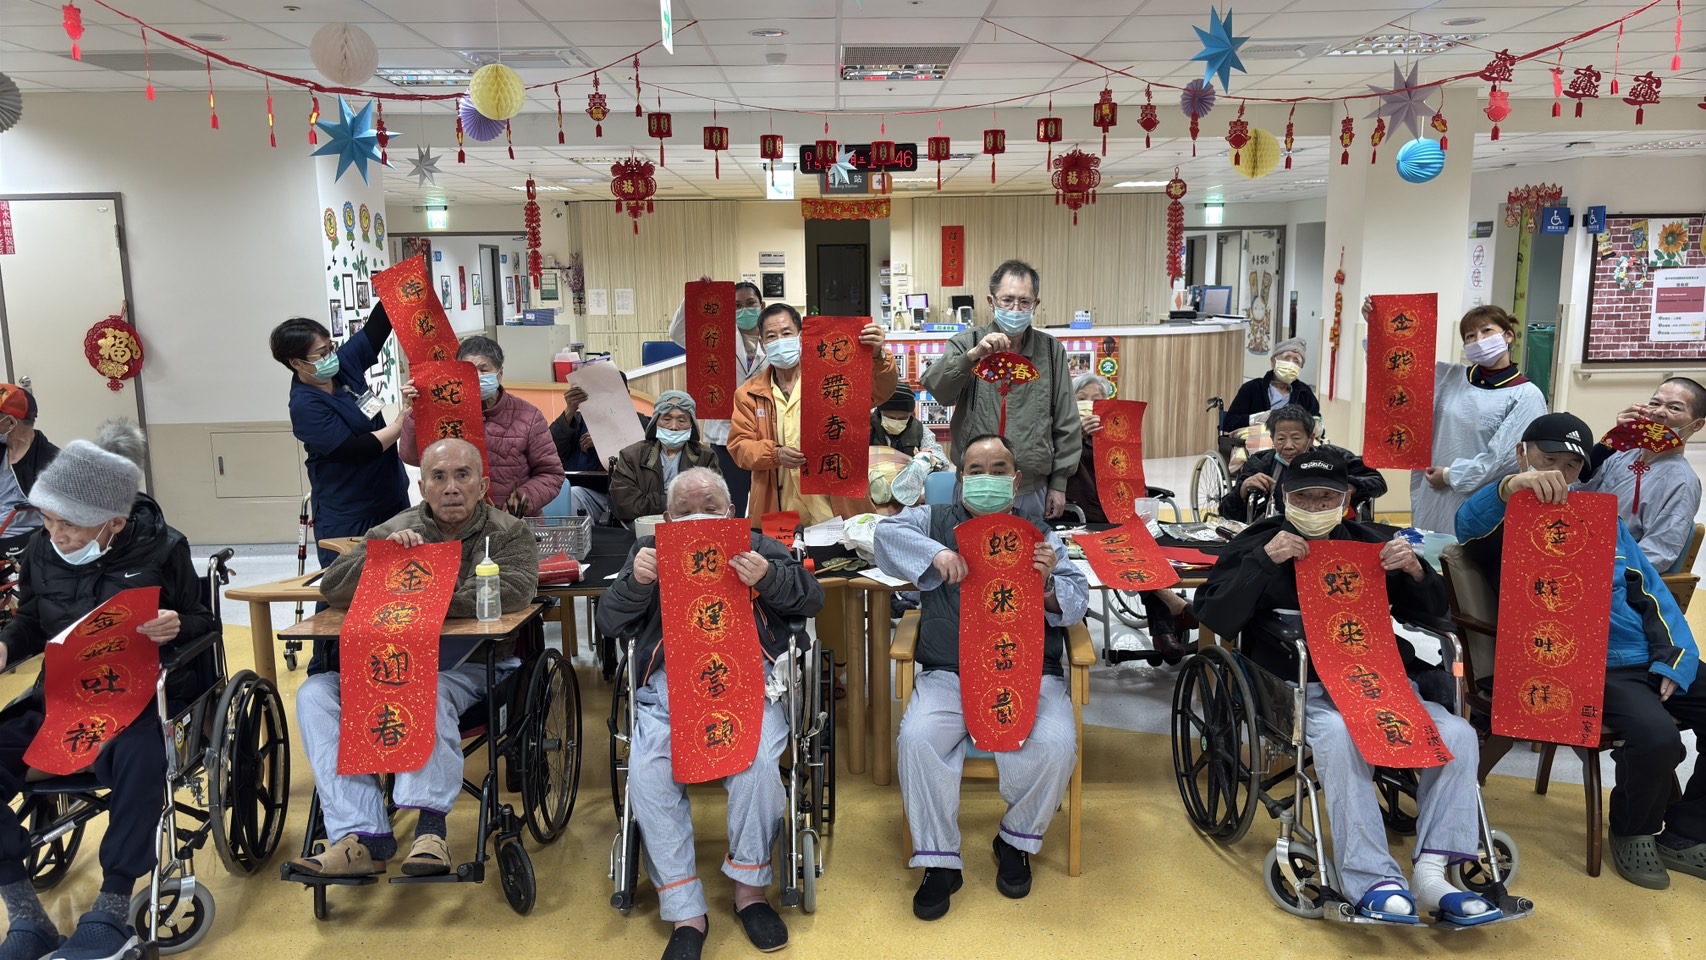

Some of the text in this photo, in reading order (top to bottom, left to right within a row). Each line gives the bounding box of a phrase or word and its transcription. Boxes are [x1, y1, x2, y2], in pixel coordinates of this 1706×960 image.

[98, 327, 131, 364] 福
[703, 302, 719, 404] 蛇行天下
[816, 337, 850, 481] 蛇舞春風
[1011, 363, 1032, 380] 春
[64, 611, 126, 753] 金蛇吐祥
[370, 559, 432, 747] 金蛇迎春
[691, 547, 734, 748] 蛇運當頭
[989, 531, 1018, 725] 蛇來富貴
[1323, 565, 1412, 747] 蛇來富貴
[1527, 519, 1571, 706] 金蛇吐祥
